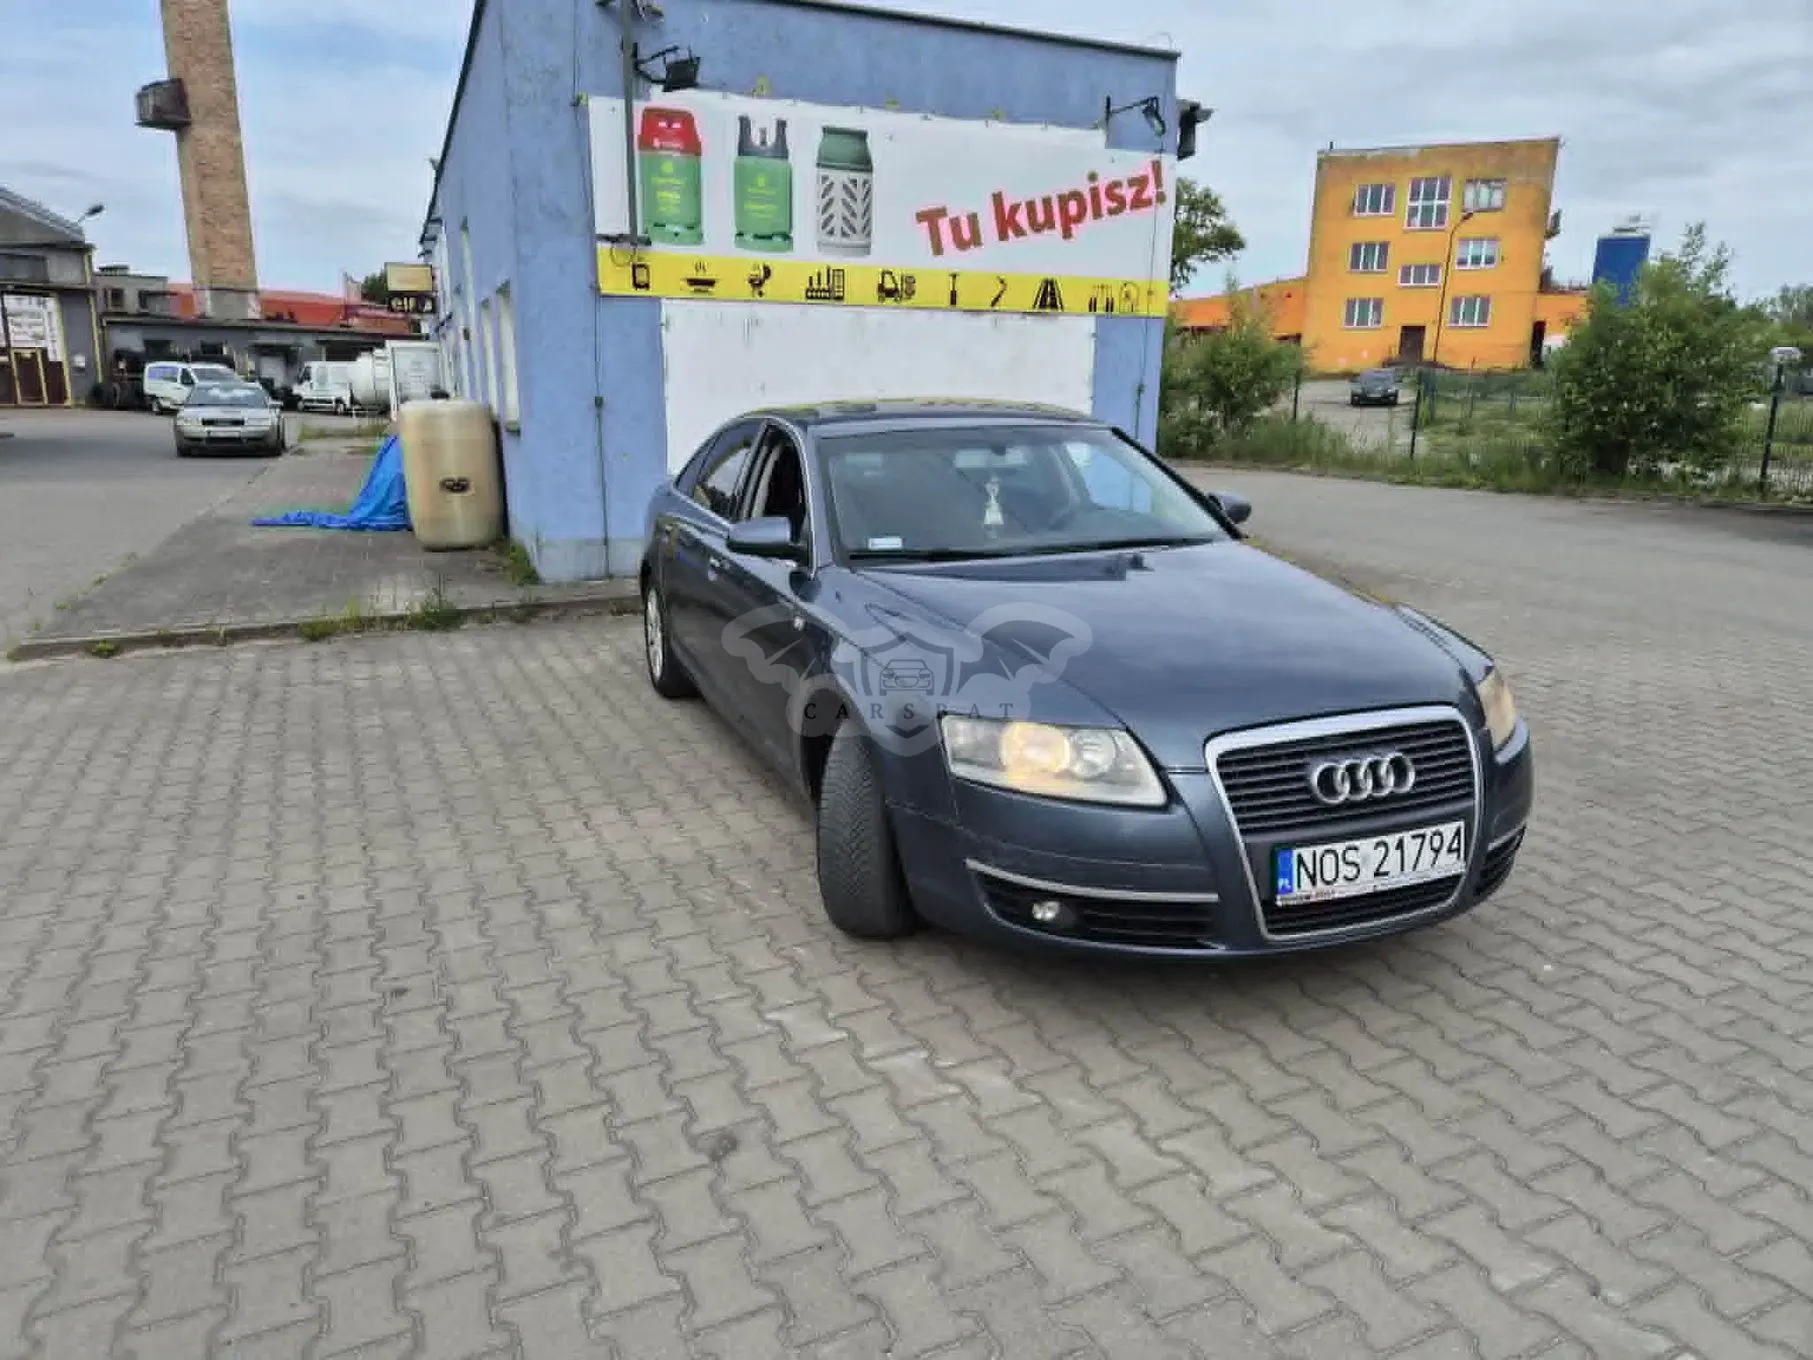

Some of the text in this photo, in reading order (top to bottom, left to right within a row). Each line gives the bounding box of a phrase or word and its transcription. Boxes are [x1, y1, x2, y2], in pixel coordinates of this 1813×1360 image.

[915, 160, 1167, 257] Tu kupisz!
[1297, 825, 1464, 889] NOS 21794
